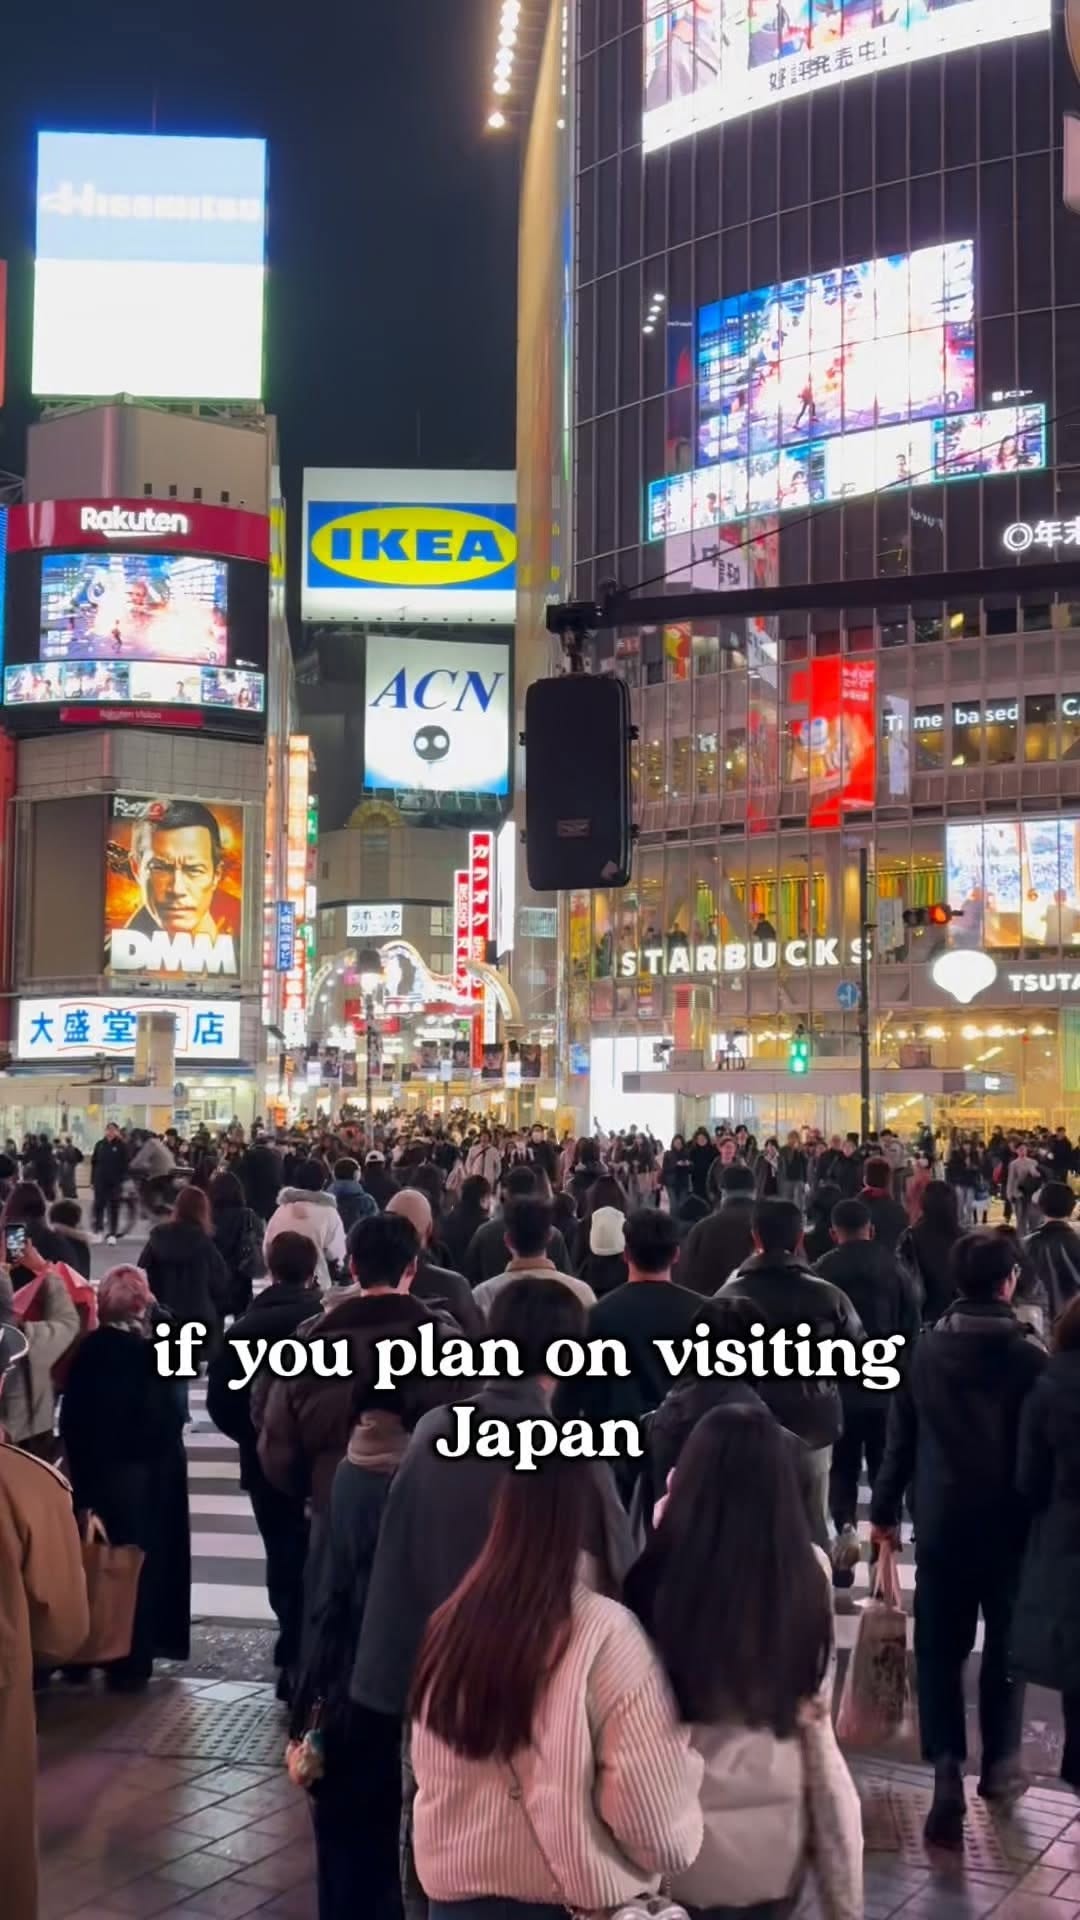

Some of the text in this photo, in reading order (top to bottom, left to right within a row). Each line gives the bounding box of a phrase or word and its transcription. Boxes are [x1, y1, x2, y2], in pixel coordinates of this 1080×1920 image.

[80, 505, 189, 535] Rakuten
[331, 528, 504, 562] IKEA
[369, 666, 505, 713] ACN
[885, 714, 943, 731] Time
[954, 704, 1019, 725] based
[472, 846, 489, 925] カラオケ
[111, 929, 237, 974] DMM
[621, 938, 872, 977] STARBUCKS
[30, 1010, 224, 1046] 大盛堂店
